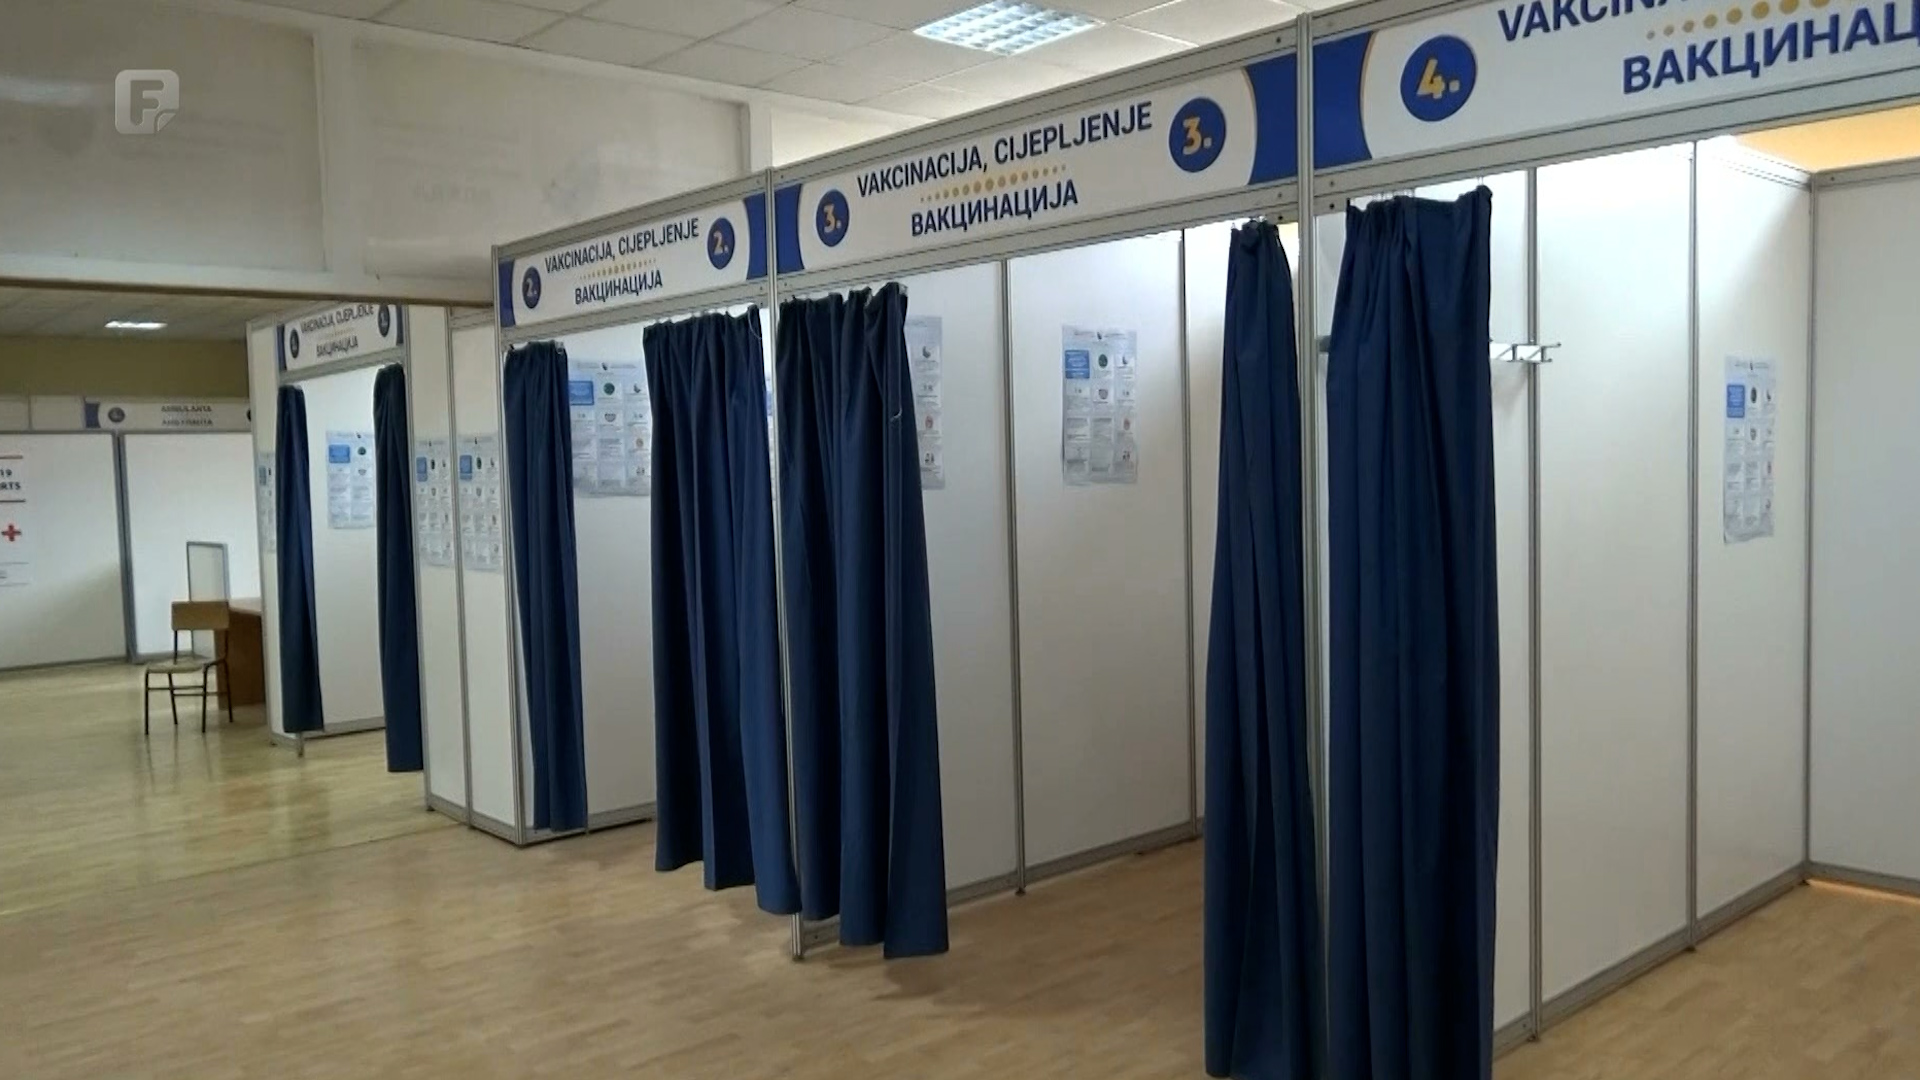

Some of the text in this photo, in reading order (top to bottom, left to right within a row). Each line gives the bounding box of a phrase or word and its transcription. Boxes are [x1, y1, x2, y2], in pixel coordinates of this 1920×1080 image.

[1416, 59, 1461, 98] 4.
[822, 101, 1212, 233] 3. VAKCINACIJA, CIJEPLJENJE 3.
[911, 179, 1079, 237] ВАКЦИНАЦИЈА
[526, 218, 728, 297] 2. VAKCINACIJA, CIJEPLJENJE 2.
[574, 269, 663, 305] ВАКЦИНАЦИЈА
